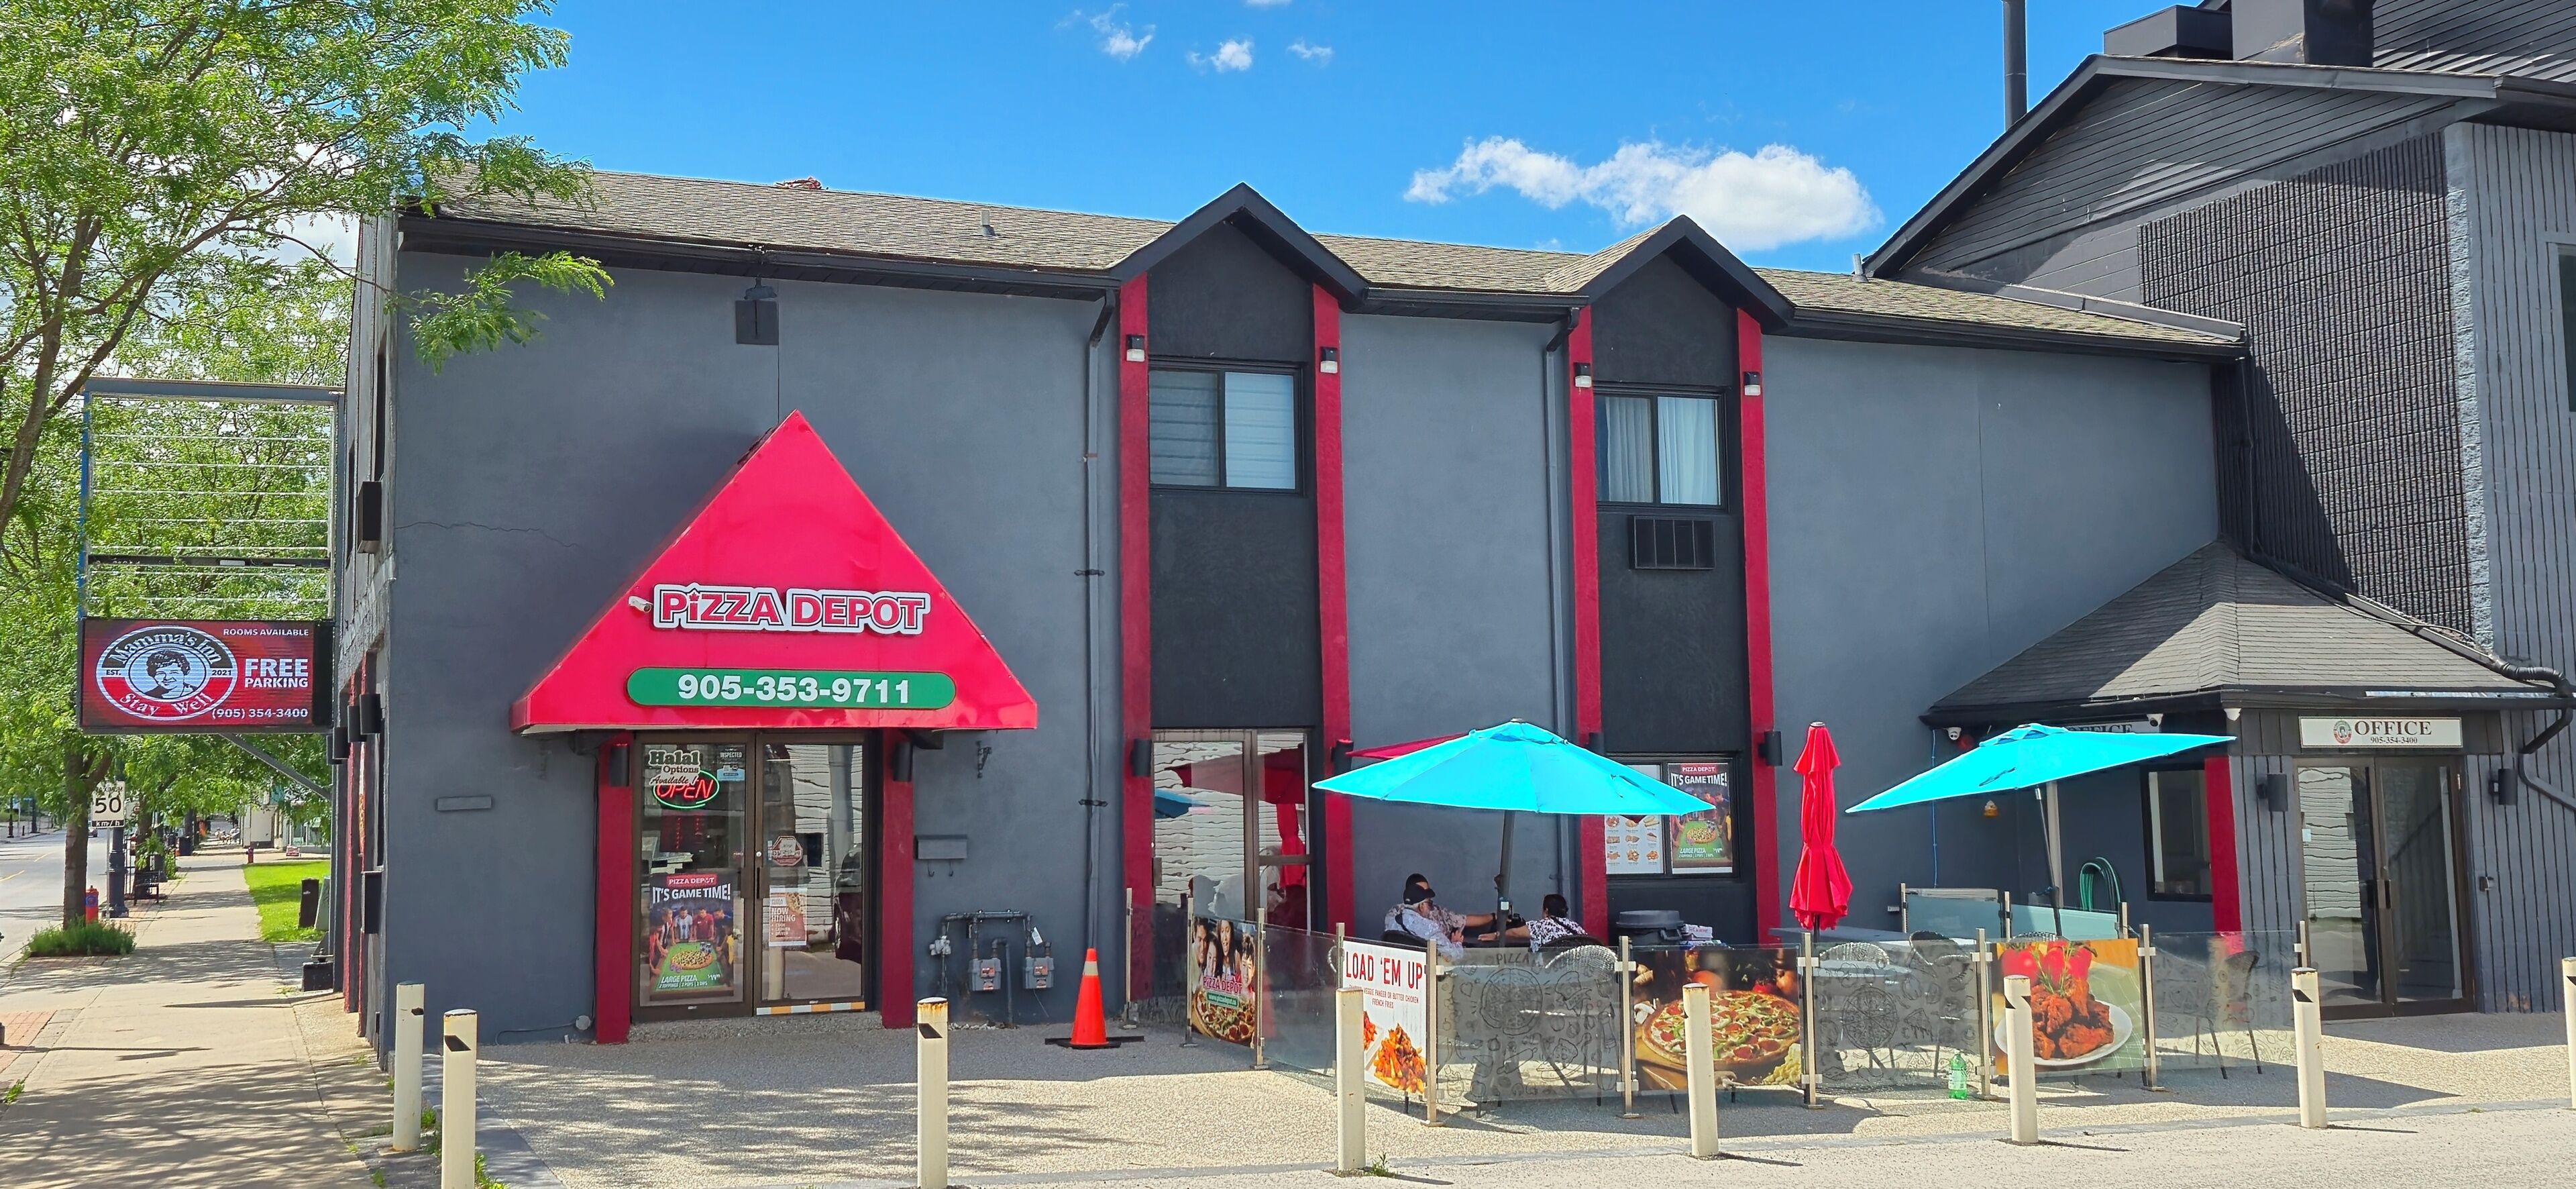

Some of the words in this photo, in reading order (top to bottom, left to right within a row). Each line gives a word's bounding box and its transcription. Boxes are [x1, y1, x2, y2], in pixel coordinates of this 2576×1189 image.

[792, 594, 928, 629] DEPOT
[109, 632, 197, 664] Mamma's
[195, 639, 222, 664] Inn
[245, 658, 309, 677] FREE
[245, 678, 308, 688] PARKING
[678, 675, 909, 703] 905-353-9711
[119, 693, 160, 716] Stay
[171, 692, 215, 714] Well
[212, 709, 245, 719] (905)
[248, 709, 308, 717] 354-3400
[2355, 721, 2432, 735] OFFICE
[649, 750, 700, 765] Halal
[663, 766, 699, 774] Options
[1670, 773, 1684, 786] IT'S
[1684, 776, 1707, 784] GAME
[1707, 772, 1727, 786] TIME!
[657, 780, 714, 798] OPEN
[95, 797, 121, 813] 50
[653, 886, 670, 904] IT'S
[672, 888, 702, 899] GAME
[702, 883, 731, 900] TIME!
[1346, 951, 1374, 981] LOAD
[1381, 958, 1401, 986] 'EM
[1408, 961, 1422, 990] UP
[1203, 976, 1220, 990] PIZZA
[1222, 980, 1242, 994] DEPOT
[1364, 987, 1374, 995] VEGGIE
[1375, 989, 1387, 998] PANEER
[1393, 992, 1404, 1001] BUTTER
[1405, 994, 1419, 1004] CHICKEN
[1372, 998, 1384, 1006] FRENCH
[1385, 1000, 1394, 1009] FRIES
